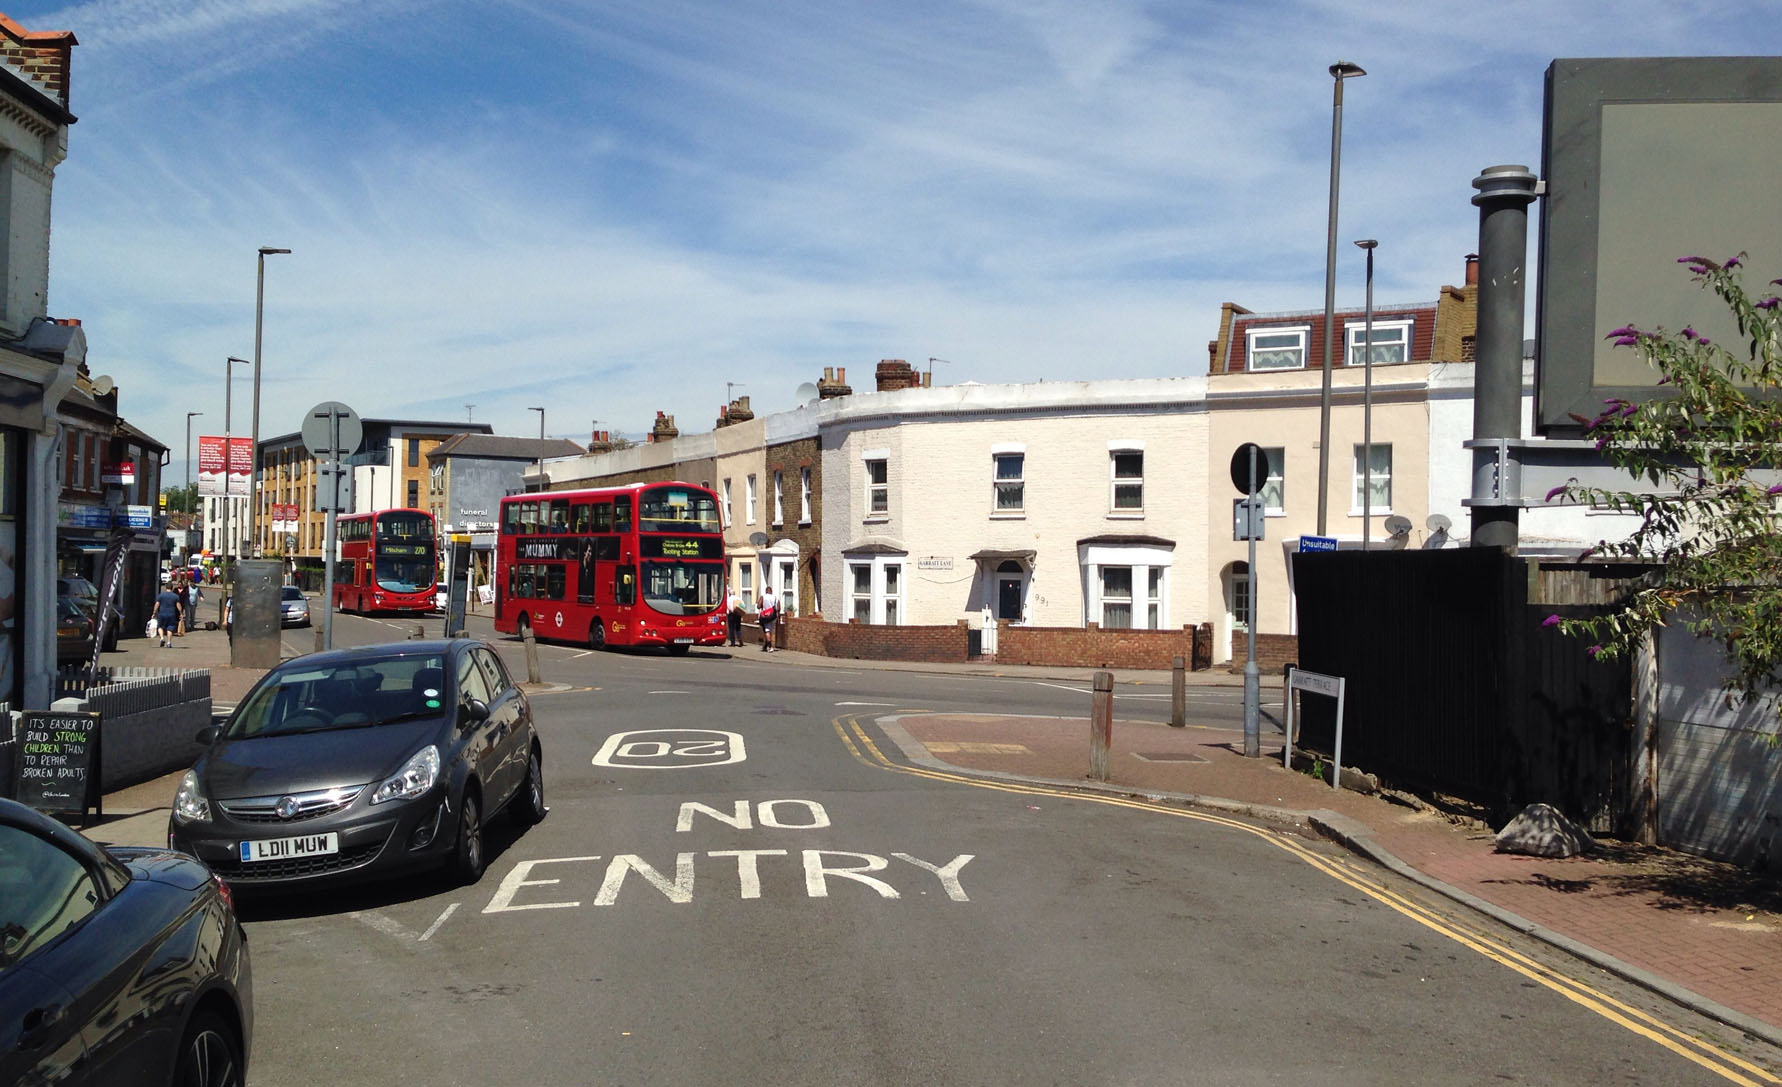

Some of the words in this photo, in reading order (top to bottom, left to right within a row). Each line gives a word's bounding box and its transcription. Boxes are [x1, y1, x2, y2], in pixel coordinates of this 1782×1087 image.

[685, 541, 699, 549] 44
[1301, 538, 1336, 550] Unsuitable
[414, 546, 426, 555] 270
[525, 543, 558, 559] MUMMY
[663, 547, 681, 557] Tooting
[29, 718, 45, 729] IT'S
[49, 719, 77, 730] EASIER
[81, 719, 94, 730] TO
[26, 730, 49, 742] BUILD
[54, 731, 87, 742] STRONG
[24, 743, 60, 754] CHILDREN
[63, 743, 84, 754] THAN
[617, 739, 726, 758] 20
[24, 755, 36, 765] TO
[40, 754, 68, 766] REPAIR
[22, 767, 53, 778] BROKEN
[676, 799, 831, 832] NO
[293, 835, 328, 854] MUW
[481, 848, 976, 914] ENTRY
